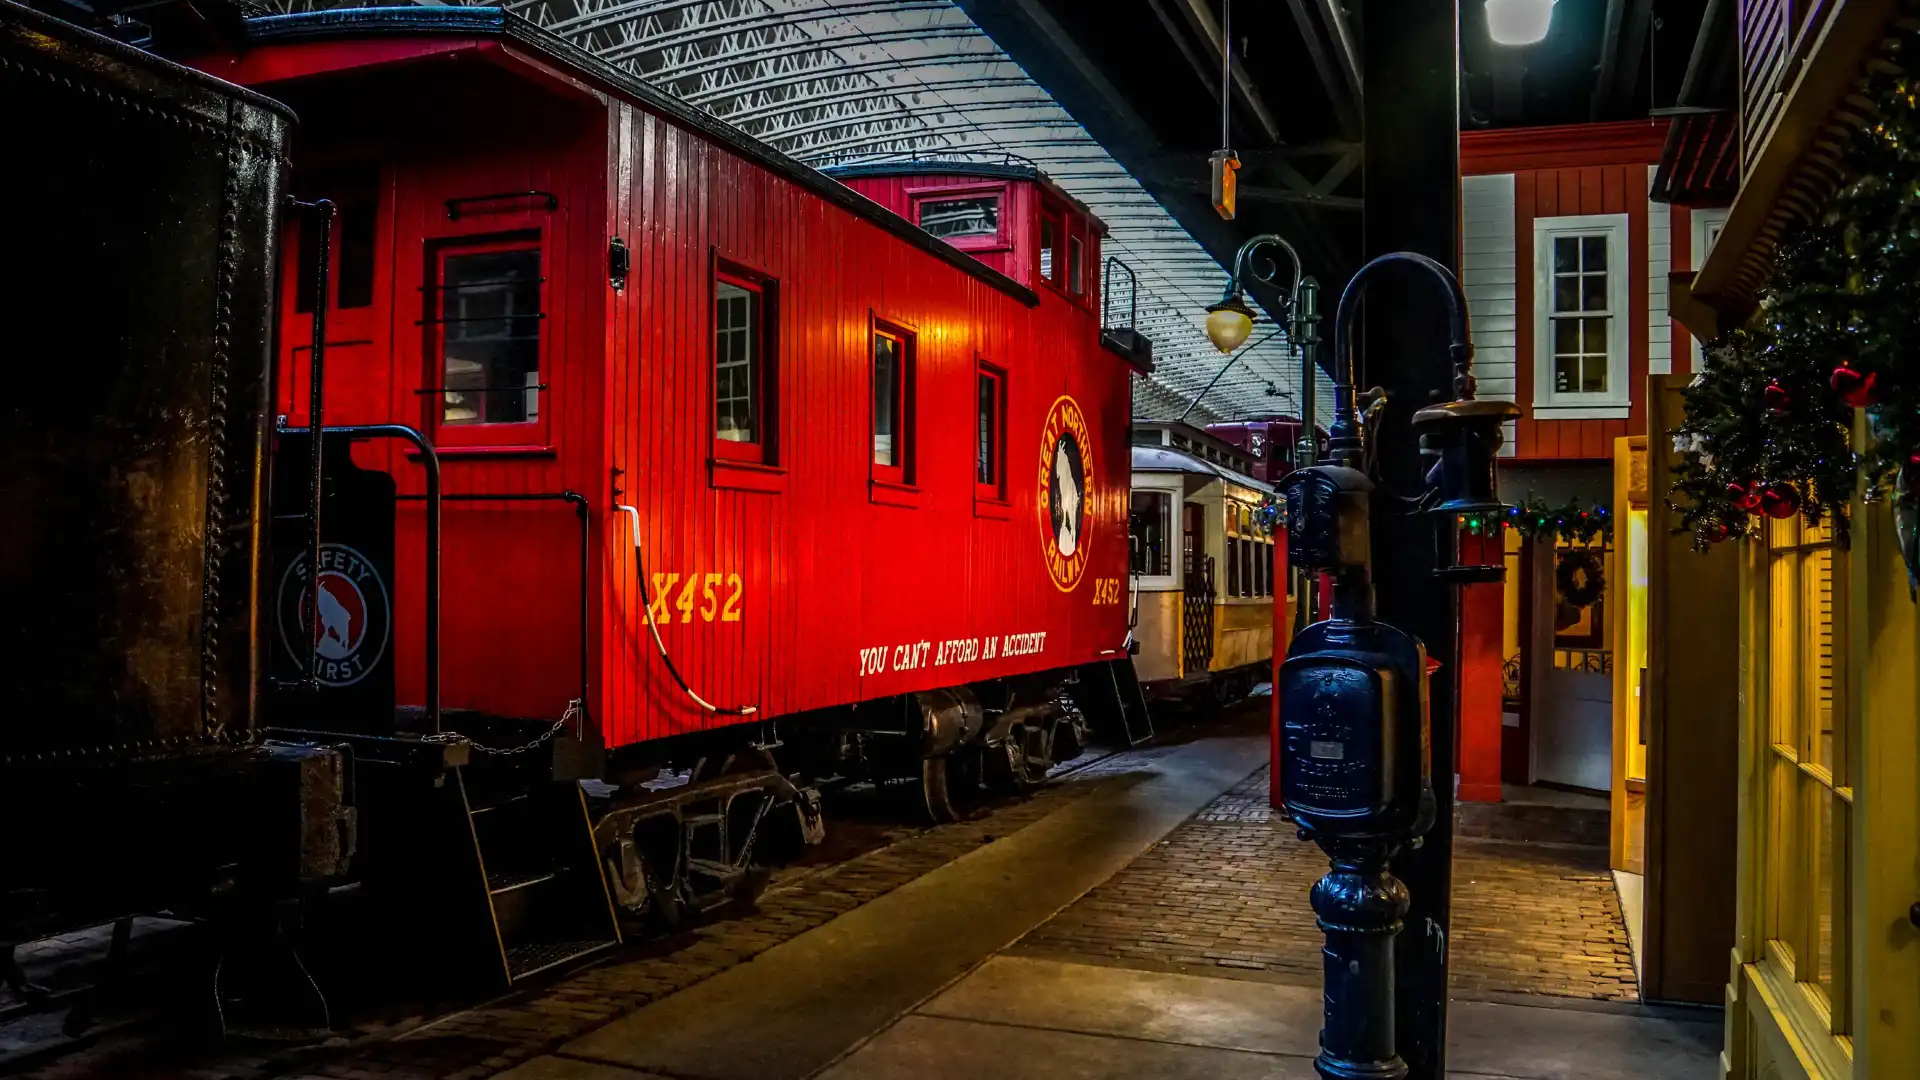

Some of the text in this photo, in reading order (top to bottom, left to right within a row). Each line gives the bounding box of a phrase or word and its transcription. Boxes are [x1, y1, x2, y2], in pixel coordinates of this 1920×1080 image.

[1040, 404, 1093, 516] GREAT NORTHERN
[296, 551, 372, 583] SFETY
[1048, 537, 1084, 584] RAILWAY
[642, 573, 742, 625] X452
[1092, 578, 1120, 605] X452
[312, 654, 364, 680] IRST
[859, 631, 1047, 677] YOU CAN'T AFFORD AN ACCIDENT
